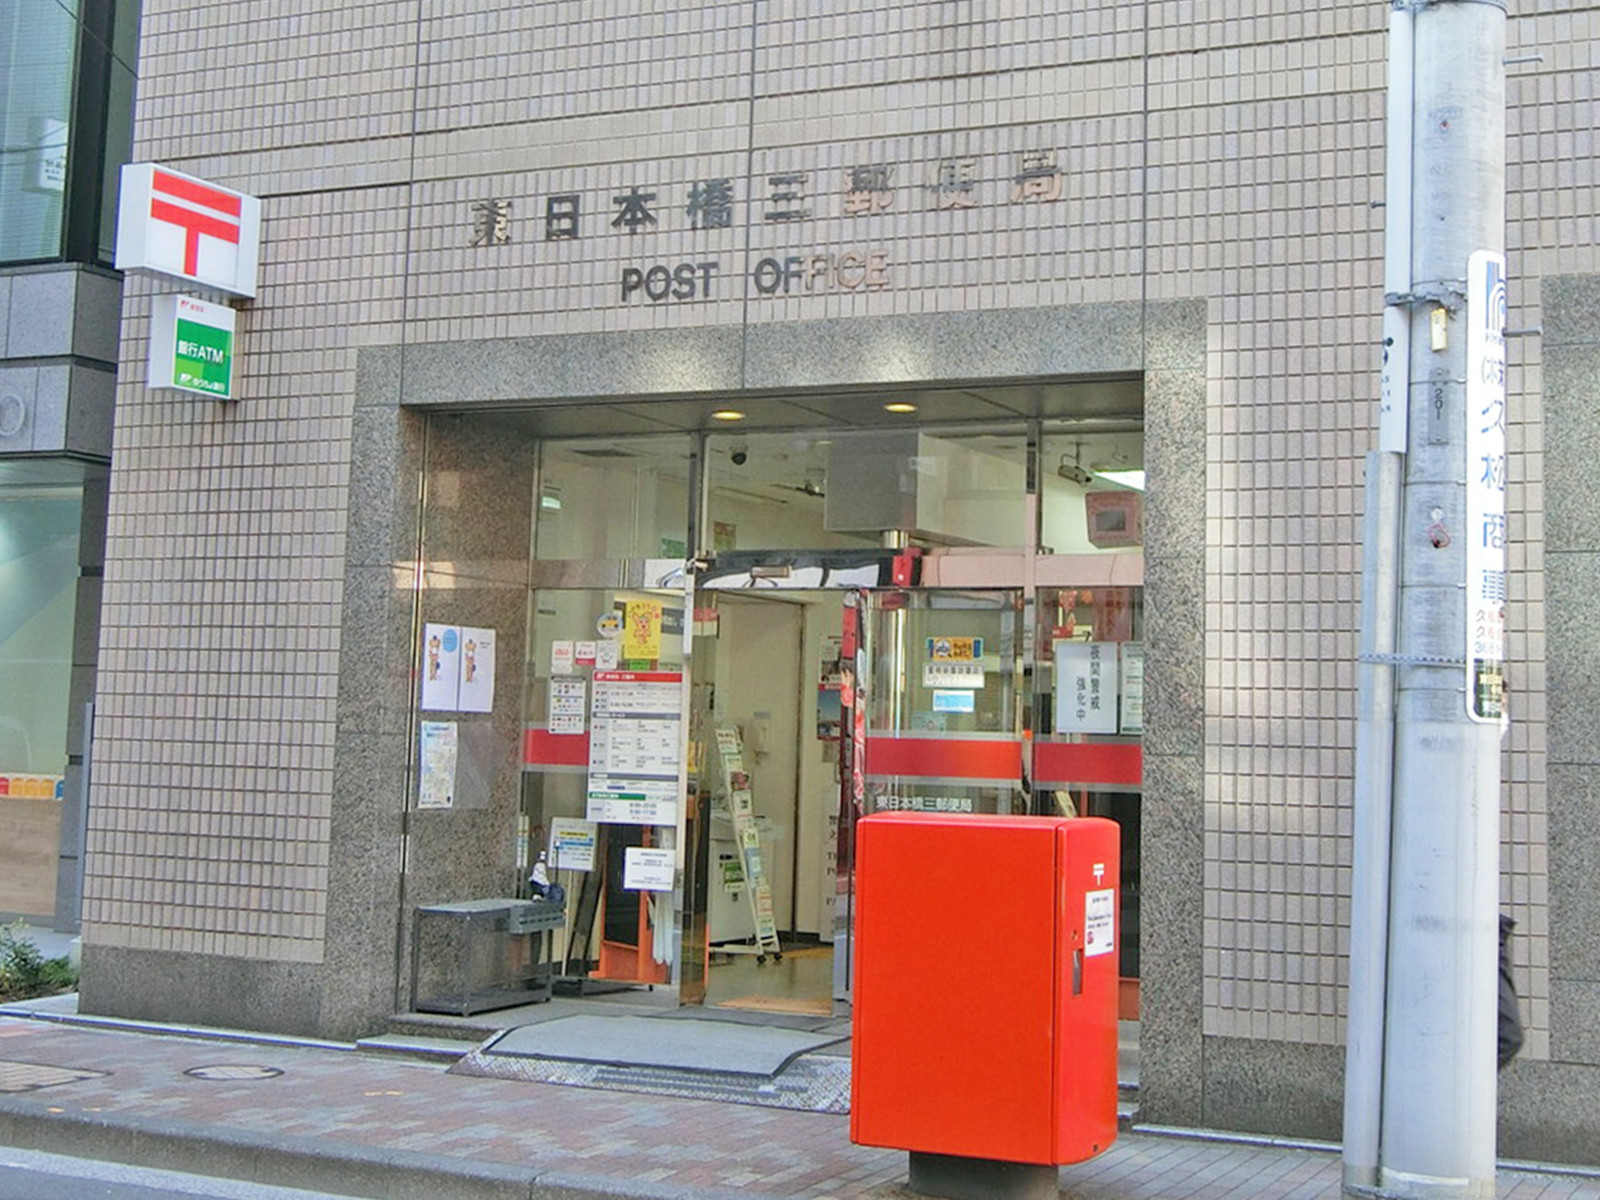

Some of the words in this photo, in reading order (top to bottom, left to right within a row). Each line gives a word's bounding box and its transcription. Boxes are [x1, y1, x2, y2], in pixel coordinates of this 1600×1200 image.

[468, 151, 1063, 246] 東日本橋三郵便局
[621, 261, 719, 301] POST
[753, 251, 889, 295] OFFICE
